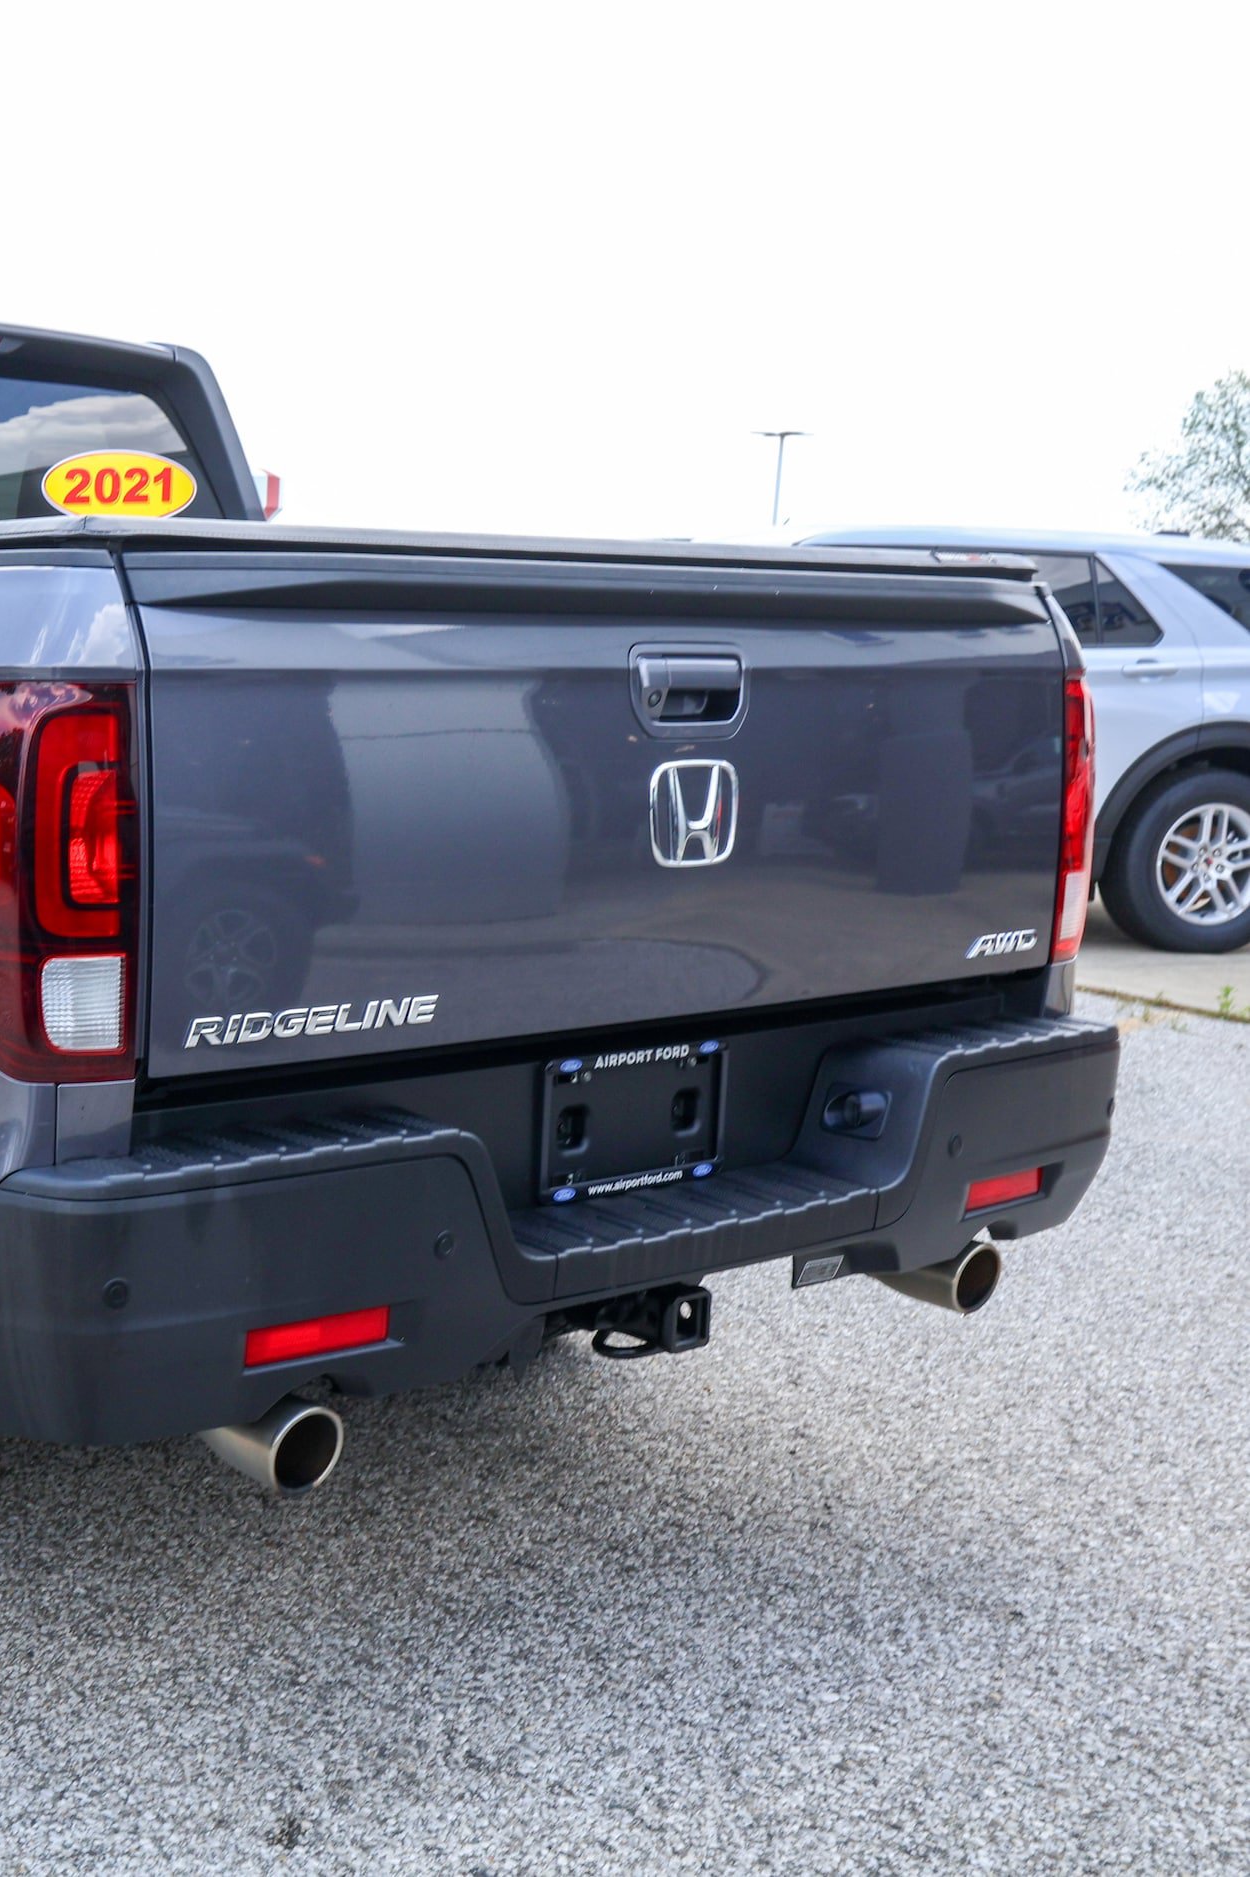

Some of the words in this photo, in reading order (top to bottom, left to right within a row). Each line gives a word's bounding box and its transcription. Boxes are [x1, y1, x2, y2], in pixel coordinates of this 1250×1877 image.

[63, 467, 172, 504] 2021
[964, 929, 1038, 959] AWD
[184, 994, 440, 1049] RIDGELINE
[594, 1049, 654, 1070] AIRPORT
[654, 1044, 690, 1062] FORD
[587, 1170, 683, 1196] www.airportford.com
